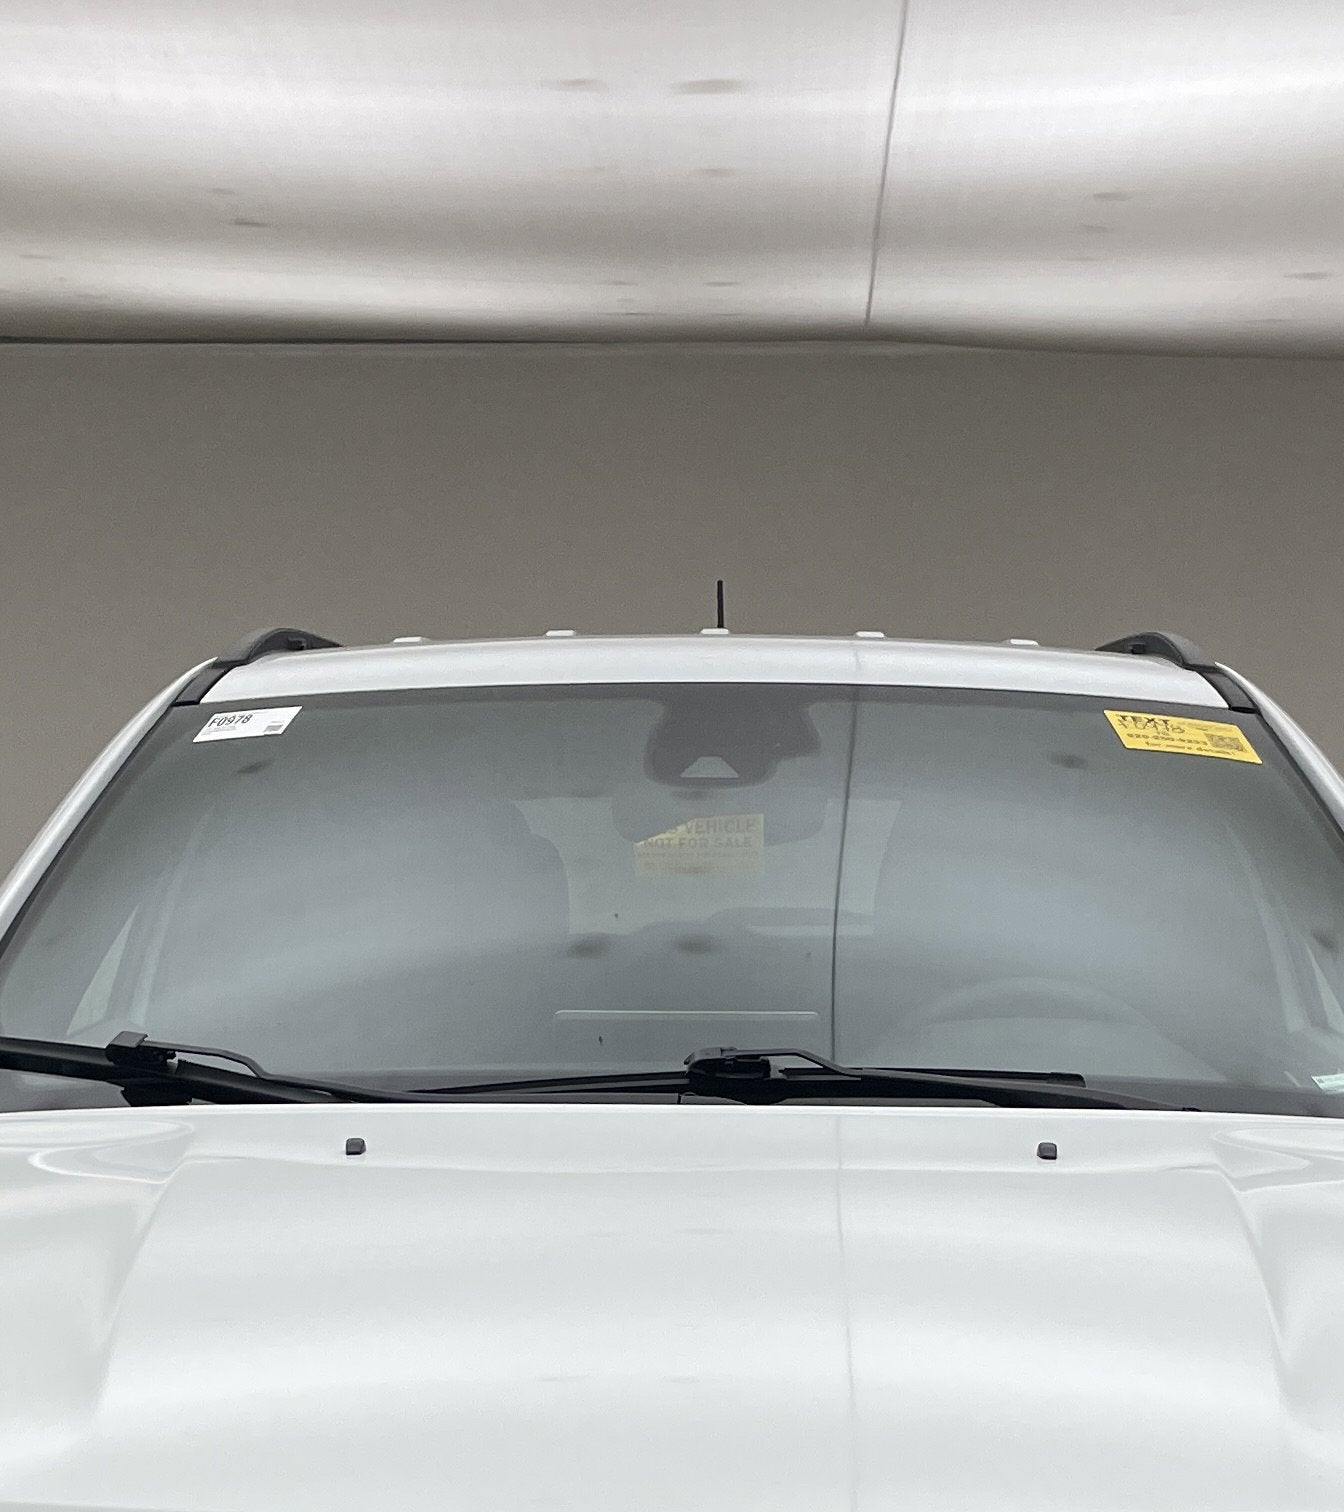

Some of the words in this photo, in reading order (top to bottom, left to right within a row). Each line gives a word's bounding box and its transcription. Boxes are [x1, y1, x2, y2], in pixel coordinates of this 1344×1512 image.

[208, 714, 254, 728] F0978
[685, 817, 757, 834] VEHICLE
[678, 838, 709, 850] FOR
[714, 837, 753, 849] SALE
